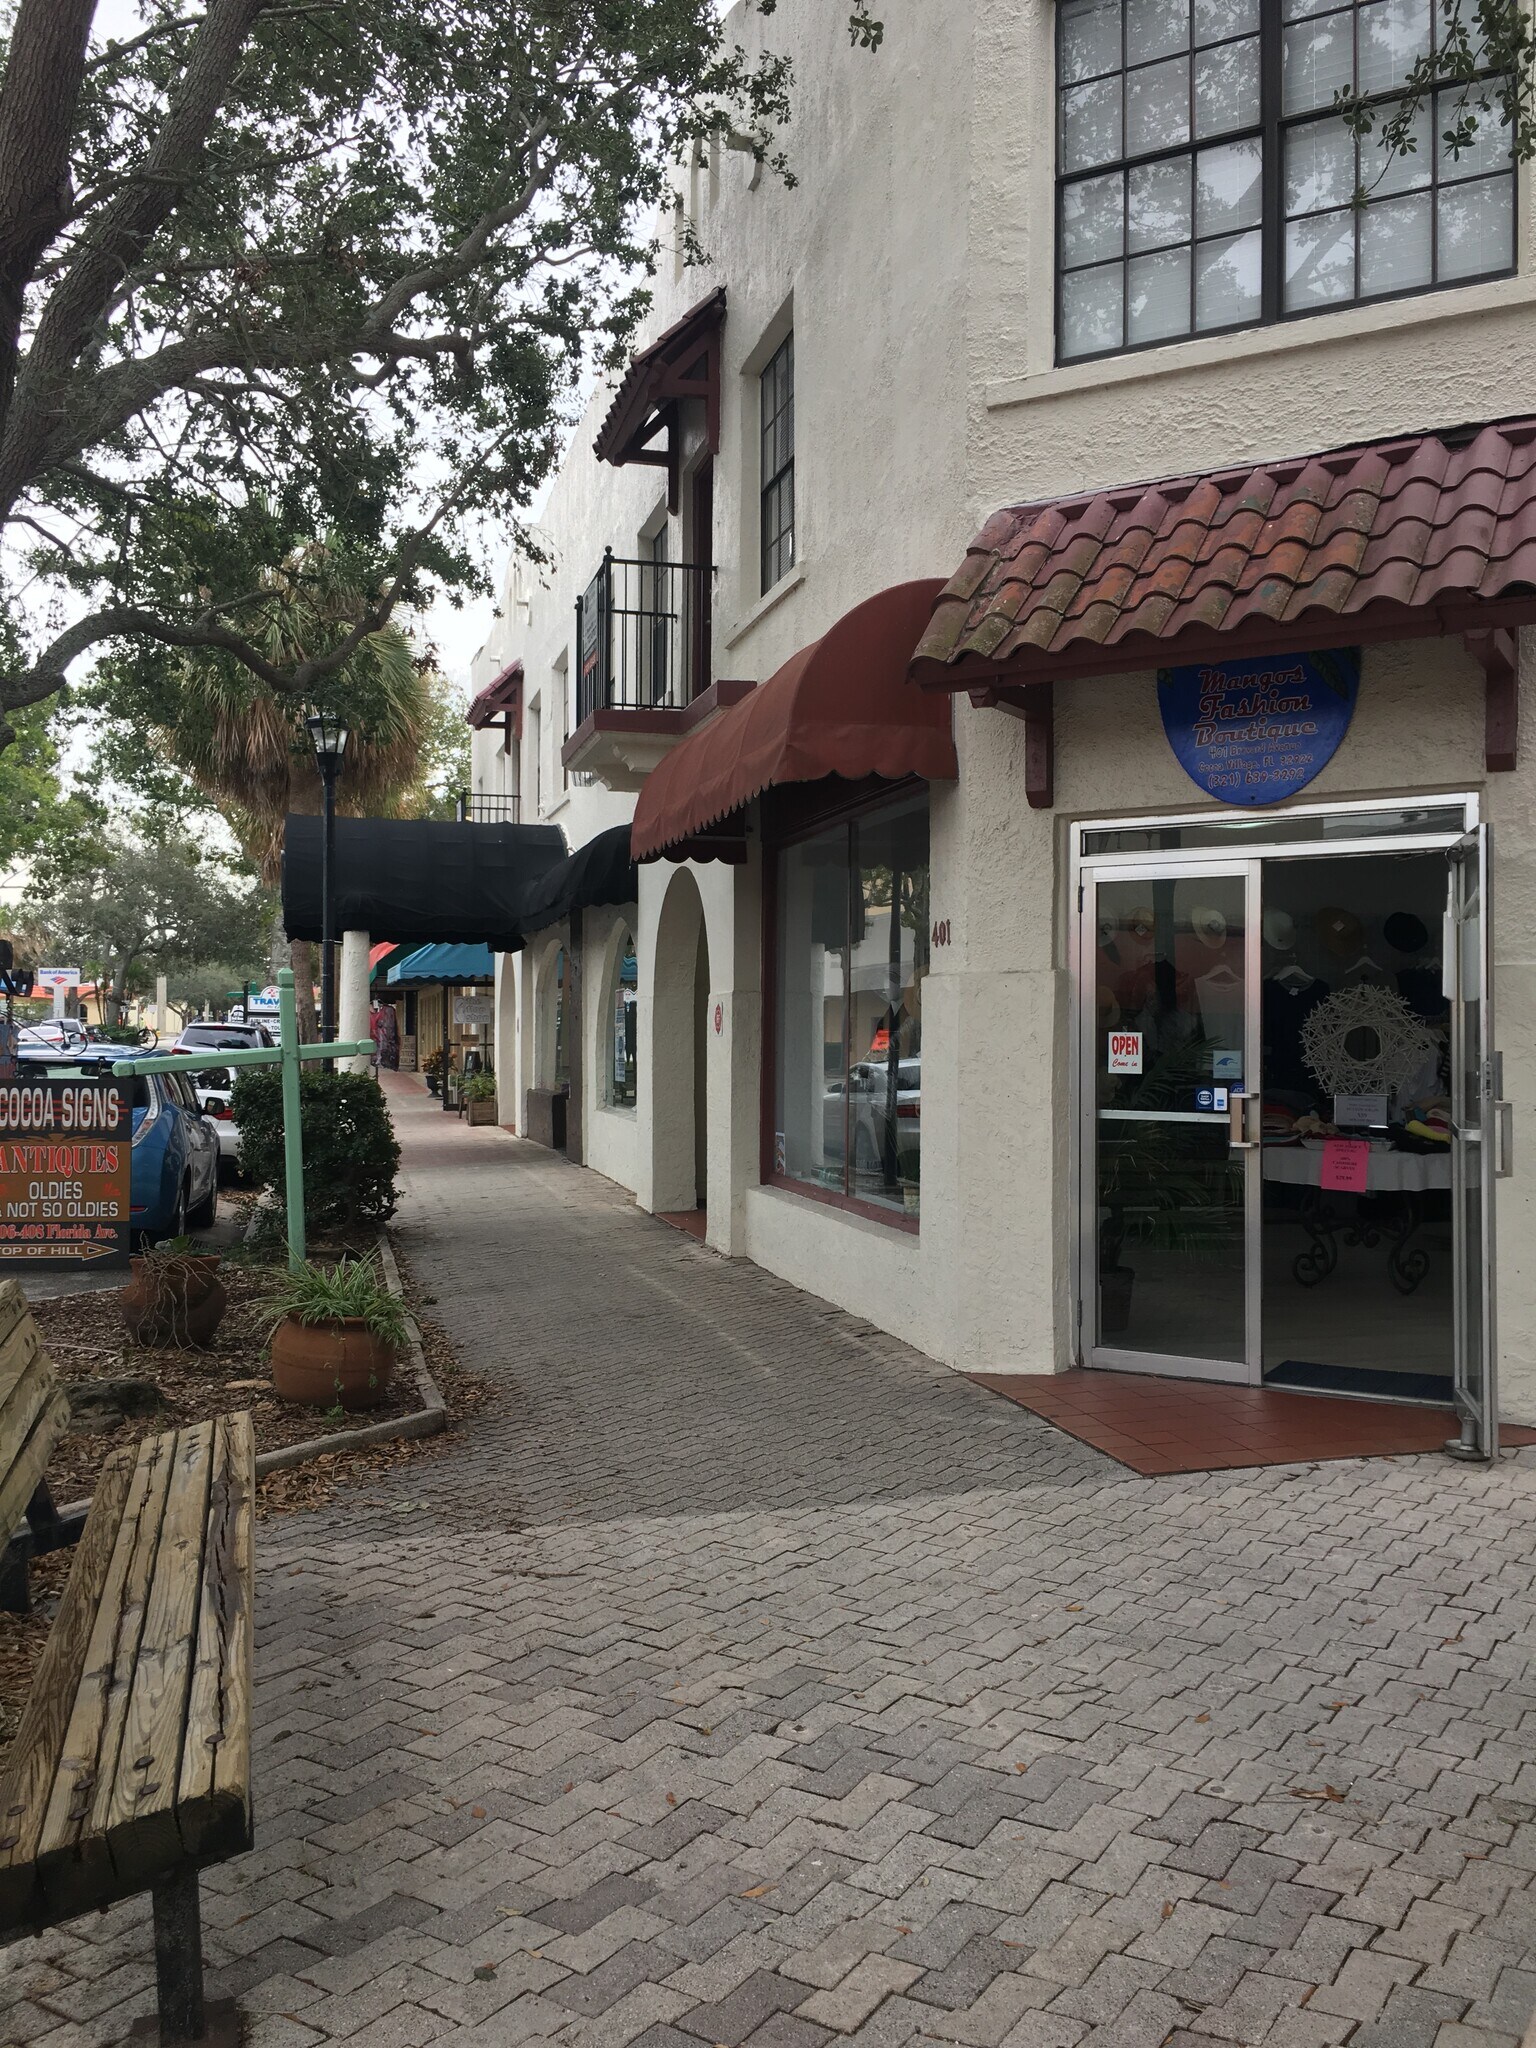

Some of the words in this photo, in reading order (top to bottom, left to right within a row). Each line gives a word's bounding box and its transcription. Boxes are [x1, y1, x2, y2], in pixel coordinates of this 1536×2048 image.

[1198, 664, 1307, 693] Mangos
[1198, 689, 1312, 721] Fashion
[1193, 716, 1318, 748] Boutique
[1209, 746, 1228, 759] 401
[1208, 772, 1241, 789] (321)
[931, 919, 951, 948] 401
[1112, 1035, 1139, 1055] OPEN
[1112, 1058, 1128, 1067] Come
[0, 1087, 55, 1128] COCOA
[61, 1087, 120, 1128] SIGNS
[0, 1145, 119, 1178] ANTIQUES
[29, 1181, 83, 1200] OLDIES
[7, 1202, 38, 1218] NOT
[42, 1201, 62, 1218] SO
[67, 1201, 119, 1218] OLDIES
[46, 1223, 91, 1240] Florida
[93, 1223, 119, 1240] Ave.
[26, 1246, 45, 1255] OF
[51, 1246, 83, 1255] HILL
